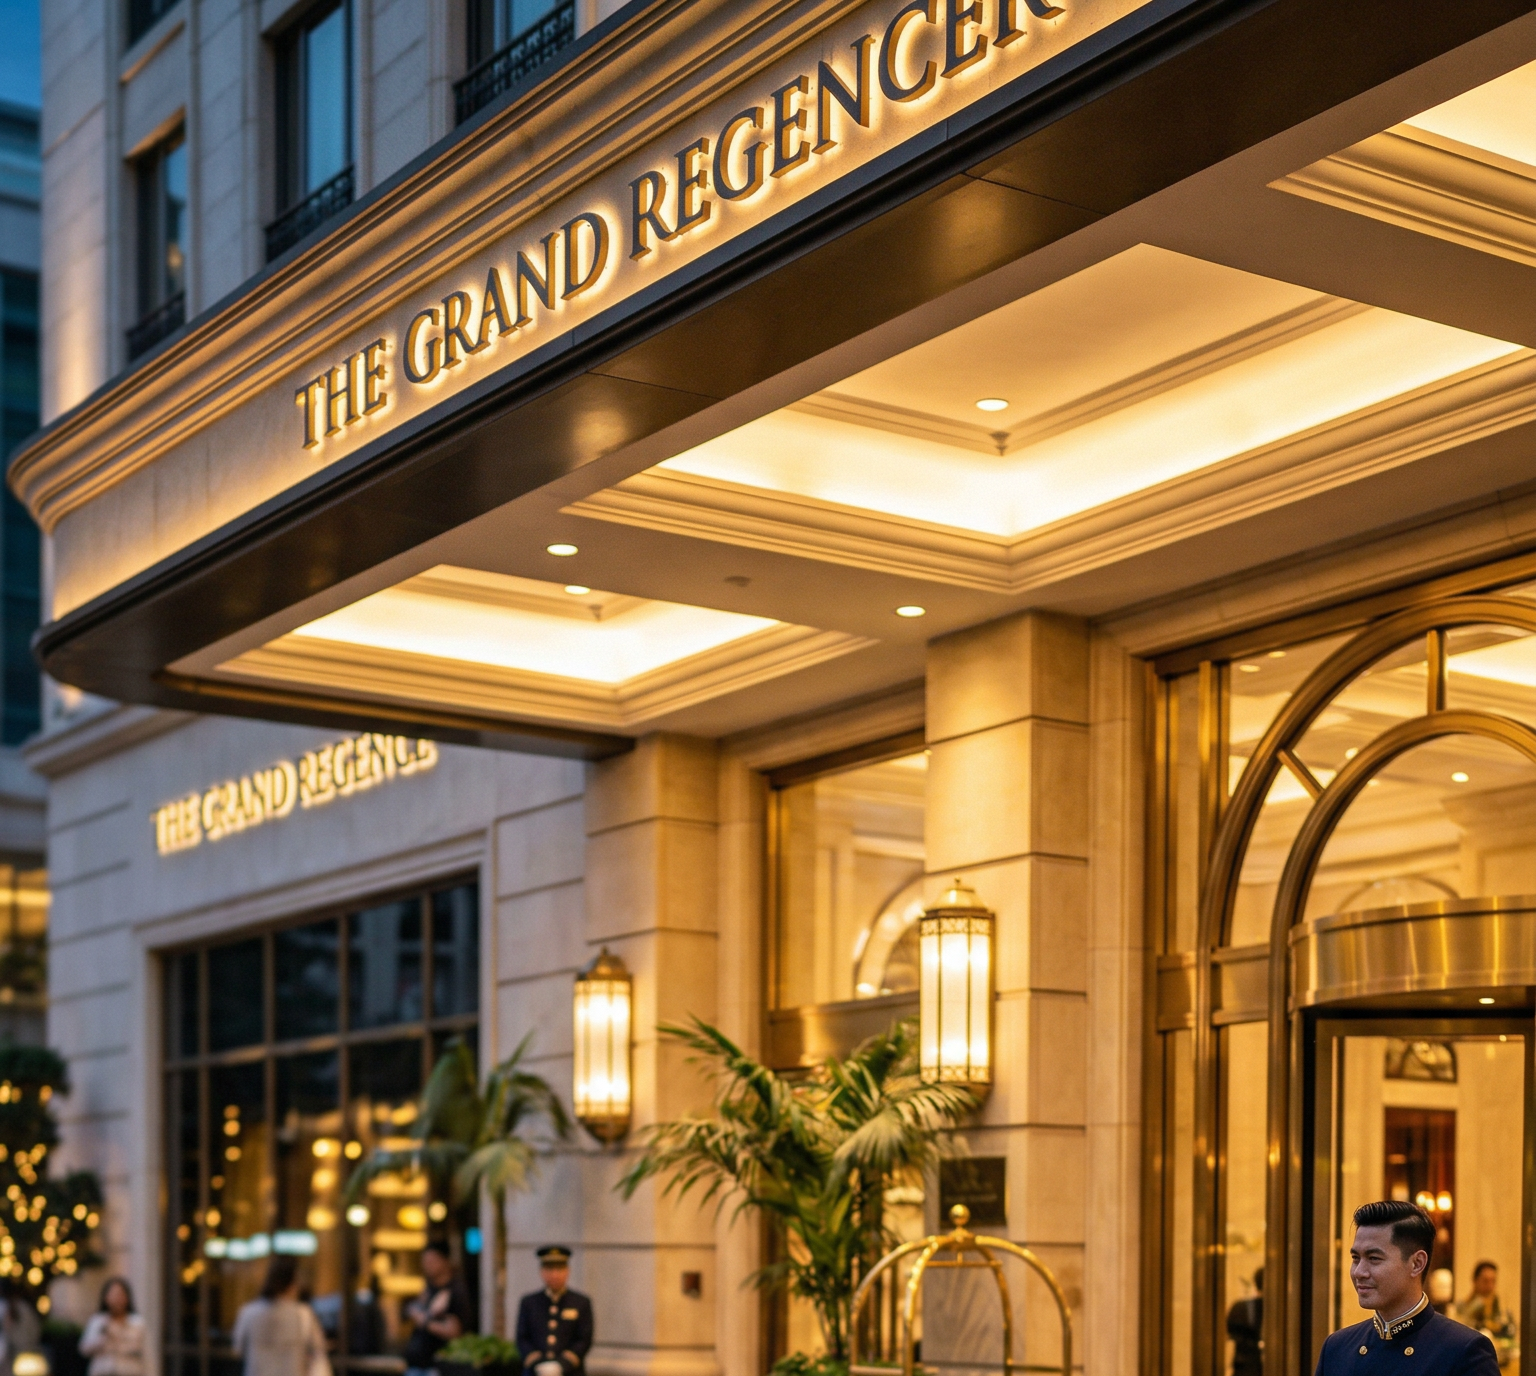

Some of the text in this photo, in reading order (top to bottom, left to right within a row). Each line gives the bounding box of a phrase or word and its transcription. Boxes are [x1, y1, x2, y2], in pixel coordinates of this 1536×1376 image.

[295, 338, 388, 450] THE
[403, 211, 611, 385] GRAND
[151, 793, 201, 854] THE
